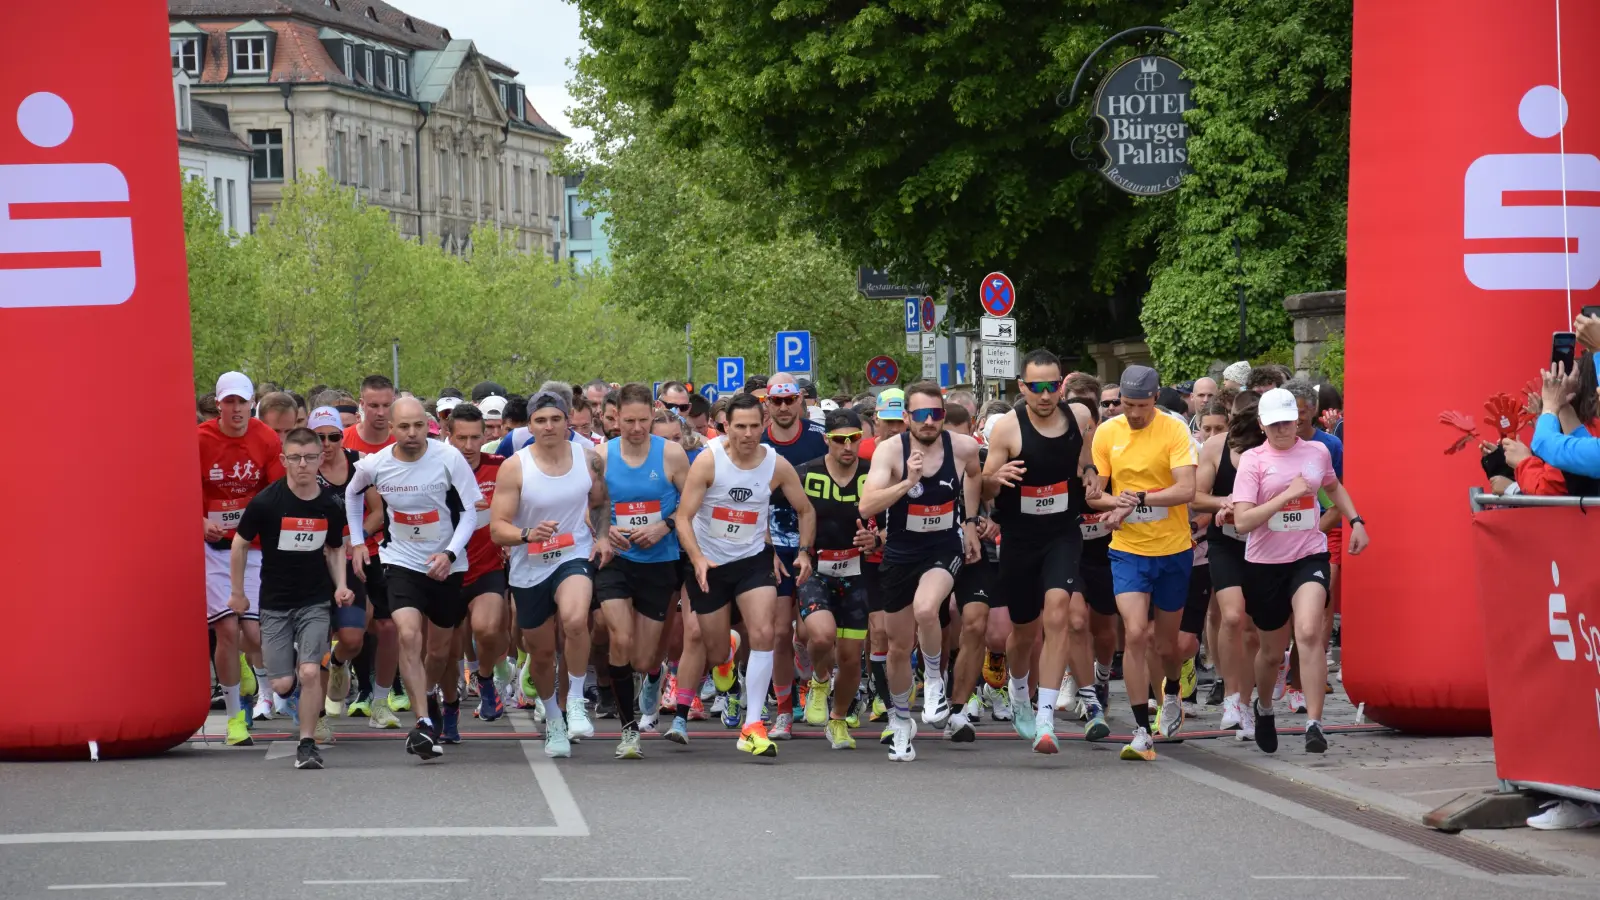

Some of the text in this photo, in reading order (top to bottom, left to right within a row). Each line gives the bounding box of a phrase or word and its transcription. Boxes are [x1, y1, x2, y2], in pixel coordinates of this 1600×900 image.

[1112, 118, 1188, 144] Bürger
[1118, 142, 1186, 165] Palais
[907, 301, 916, 329] P
[784, 336, 802, 368] P
[987, 348, 1010, 357] Liefer-
[986, 358, 1011, 366] verkehr
[723, 361, 738, 388] P
[993, 367, 1005, 375] frei
[381, 484, 419, 493] Edelmann
[1035, 497, 1054, 507] 209
[222, 511, 240, 521] 596
[629, 515, 649, 526] 439
[922, 516, 941, 525] 150
[1283, 512, 1302, 522] 560
[413, 526, 420, 535] 2
[727, 523, 740, 533] 87
[1086, 525, 1098, 533] 74
[294, 532, 314, 542] 474
[542, 550, 562, 560] 576
[831, 561, 849, 570] 416
